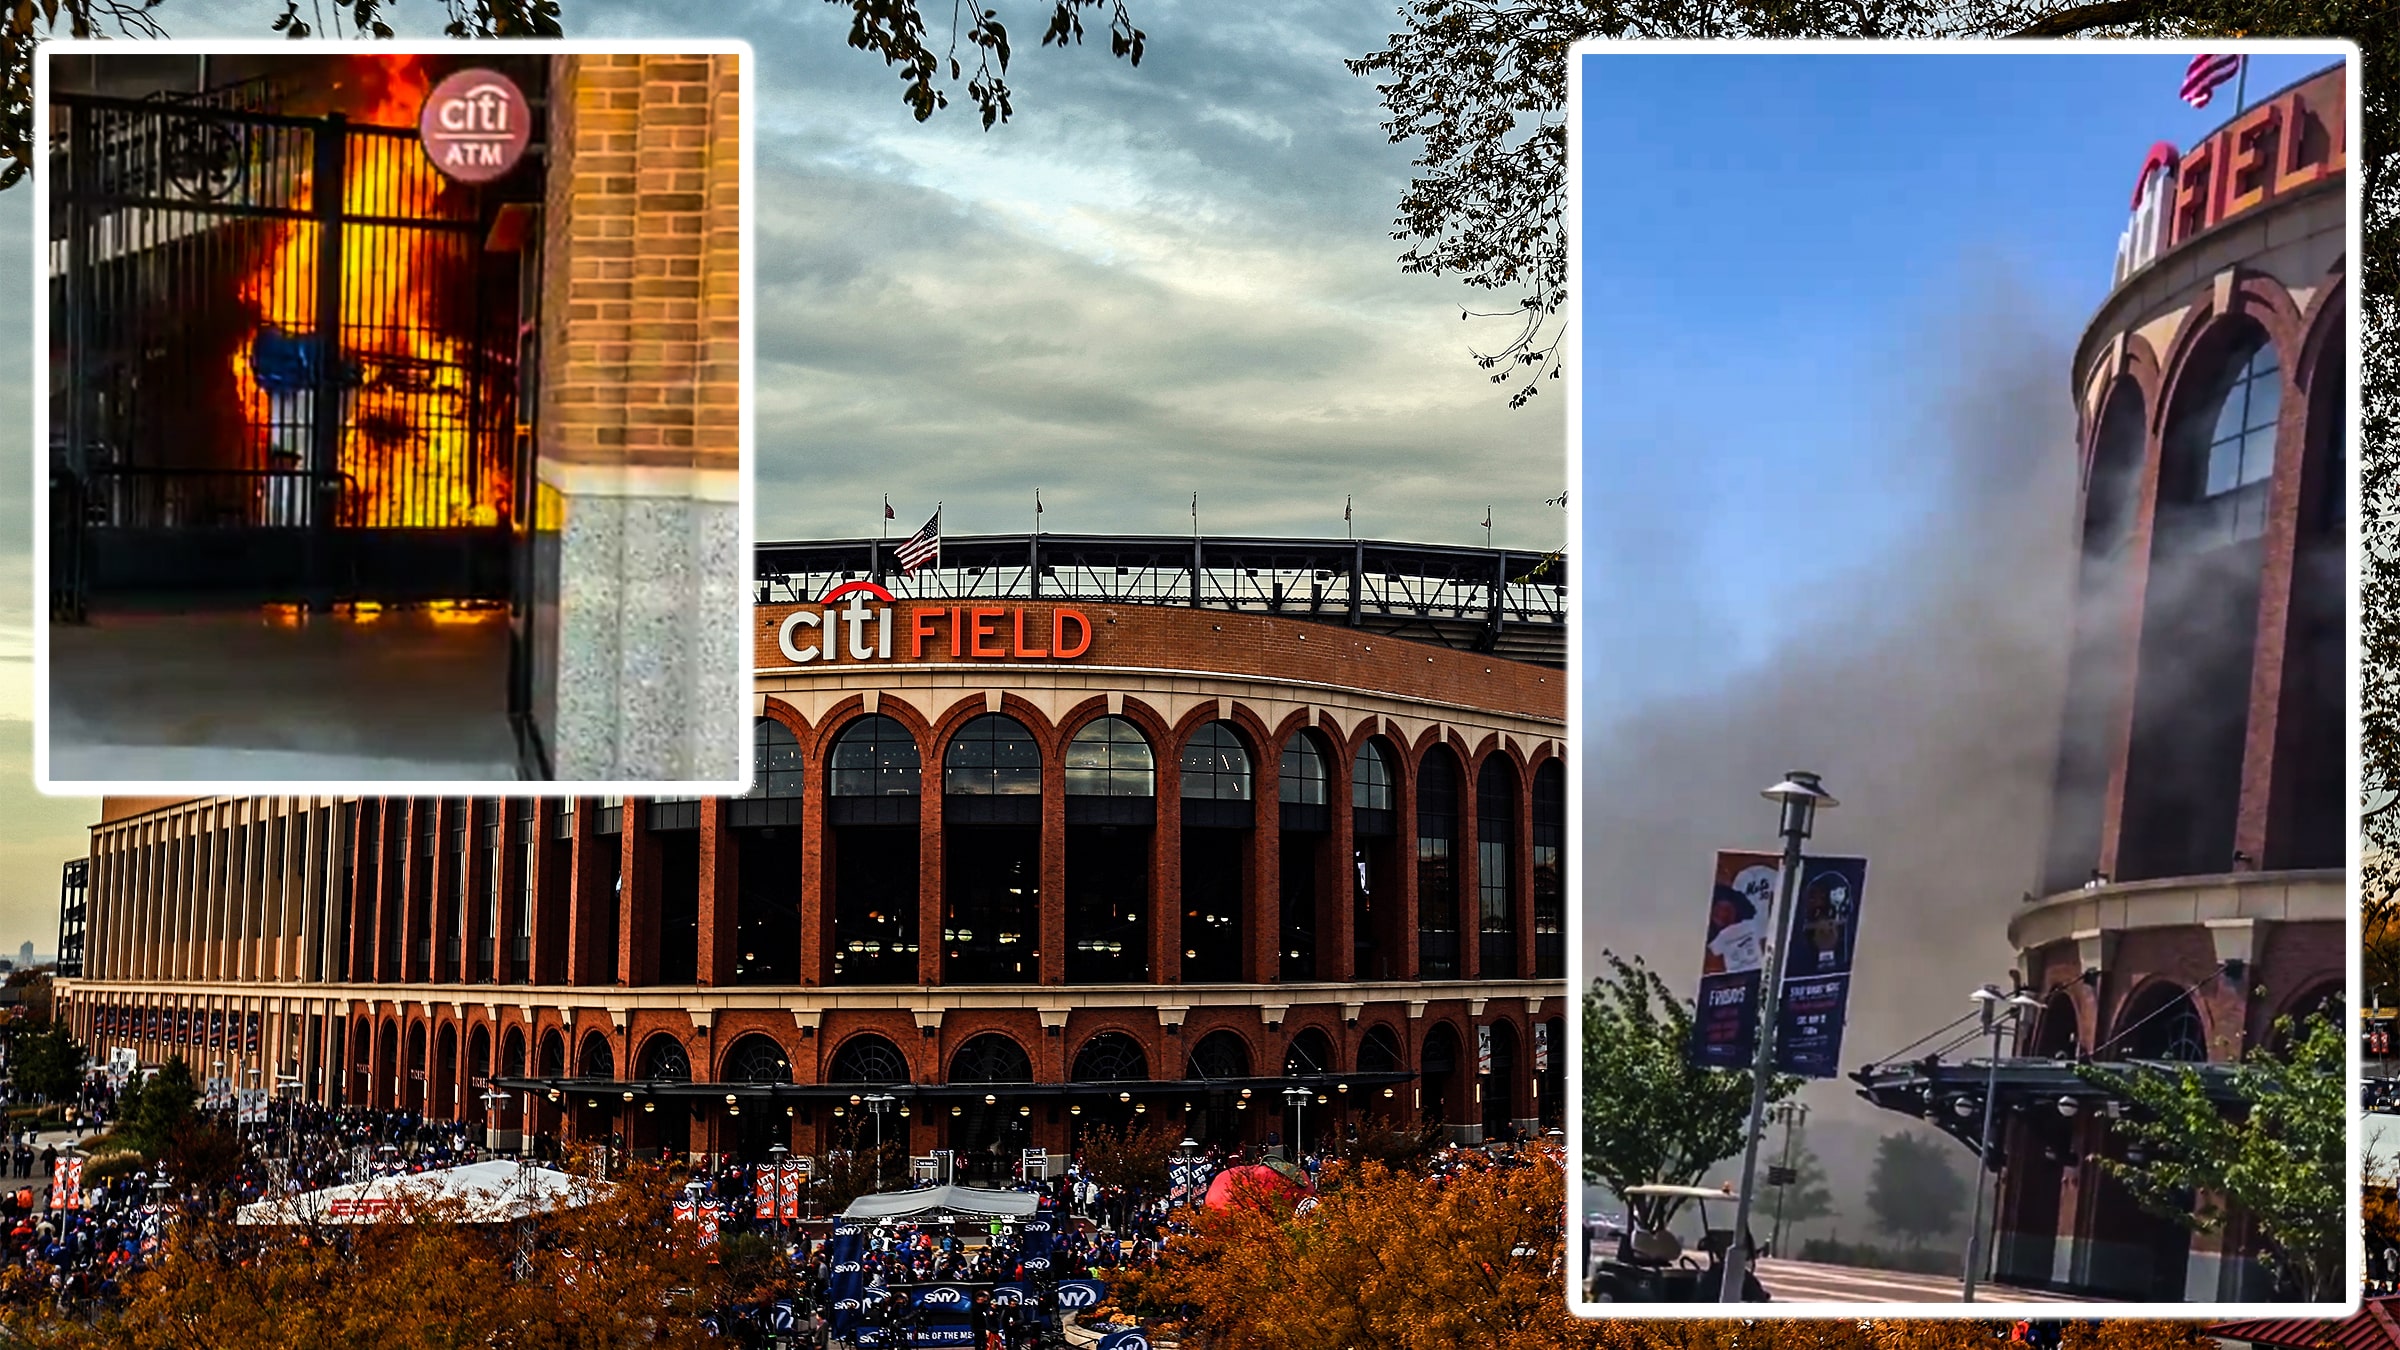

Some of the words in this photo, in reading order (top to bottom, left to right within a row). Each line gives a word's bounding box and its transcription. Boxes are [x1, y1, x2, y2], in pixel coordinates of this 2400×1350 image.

[439, 84, 511, 131] citi
[445, 142, 503, 165] ATM
[778, 581, 896, 662] citi
[911, 607, 1092, 659] FIELD
[835, 1226, 859, 1236] SNY
[1024, 1222, 1048, 1232] SNY
[834, 1263, 859, 1273] SNY
[1024, 1259, 1048, 1269] SNY
[924, 1290, 957, 1304] SNY
[1058, 1290, 1089, 1306] NY
[907, 1332, 930, 1340] HME
[943, 1332, 959, 1340] THE
